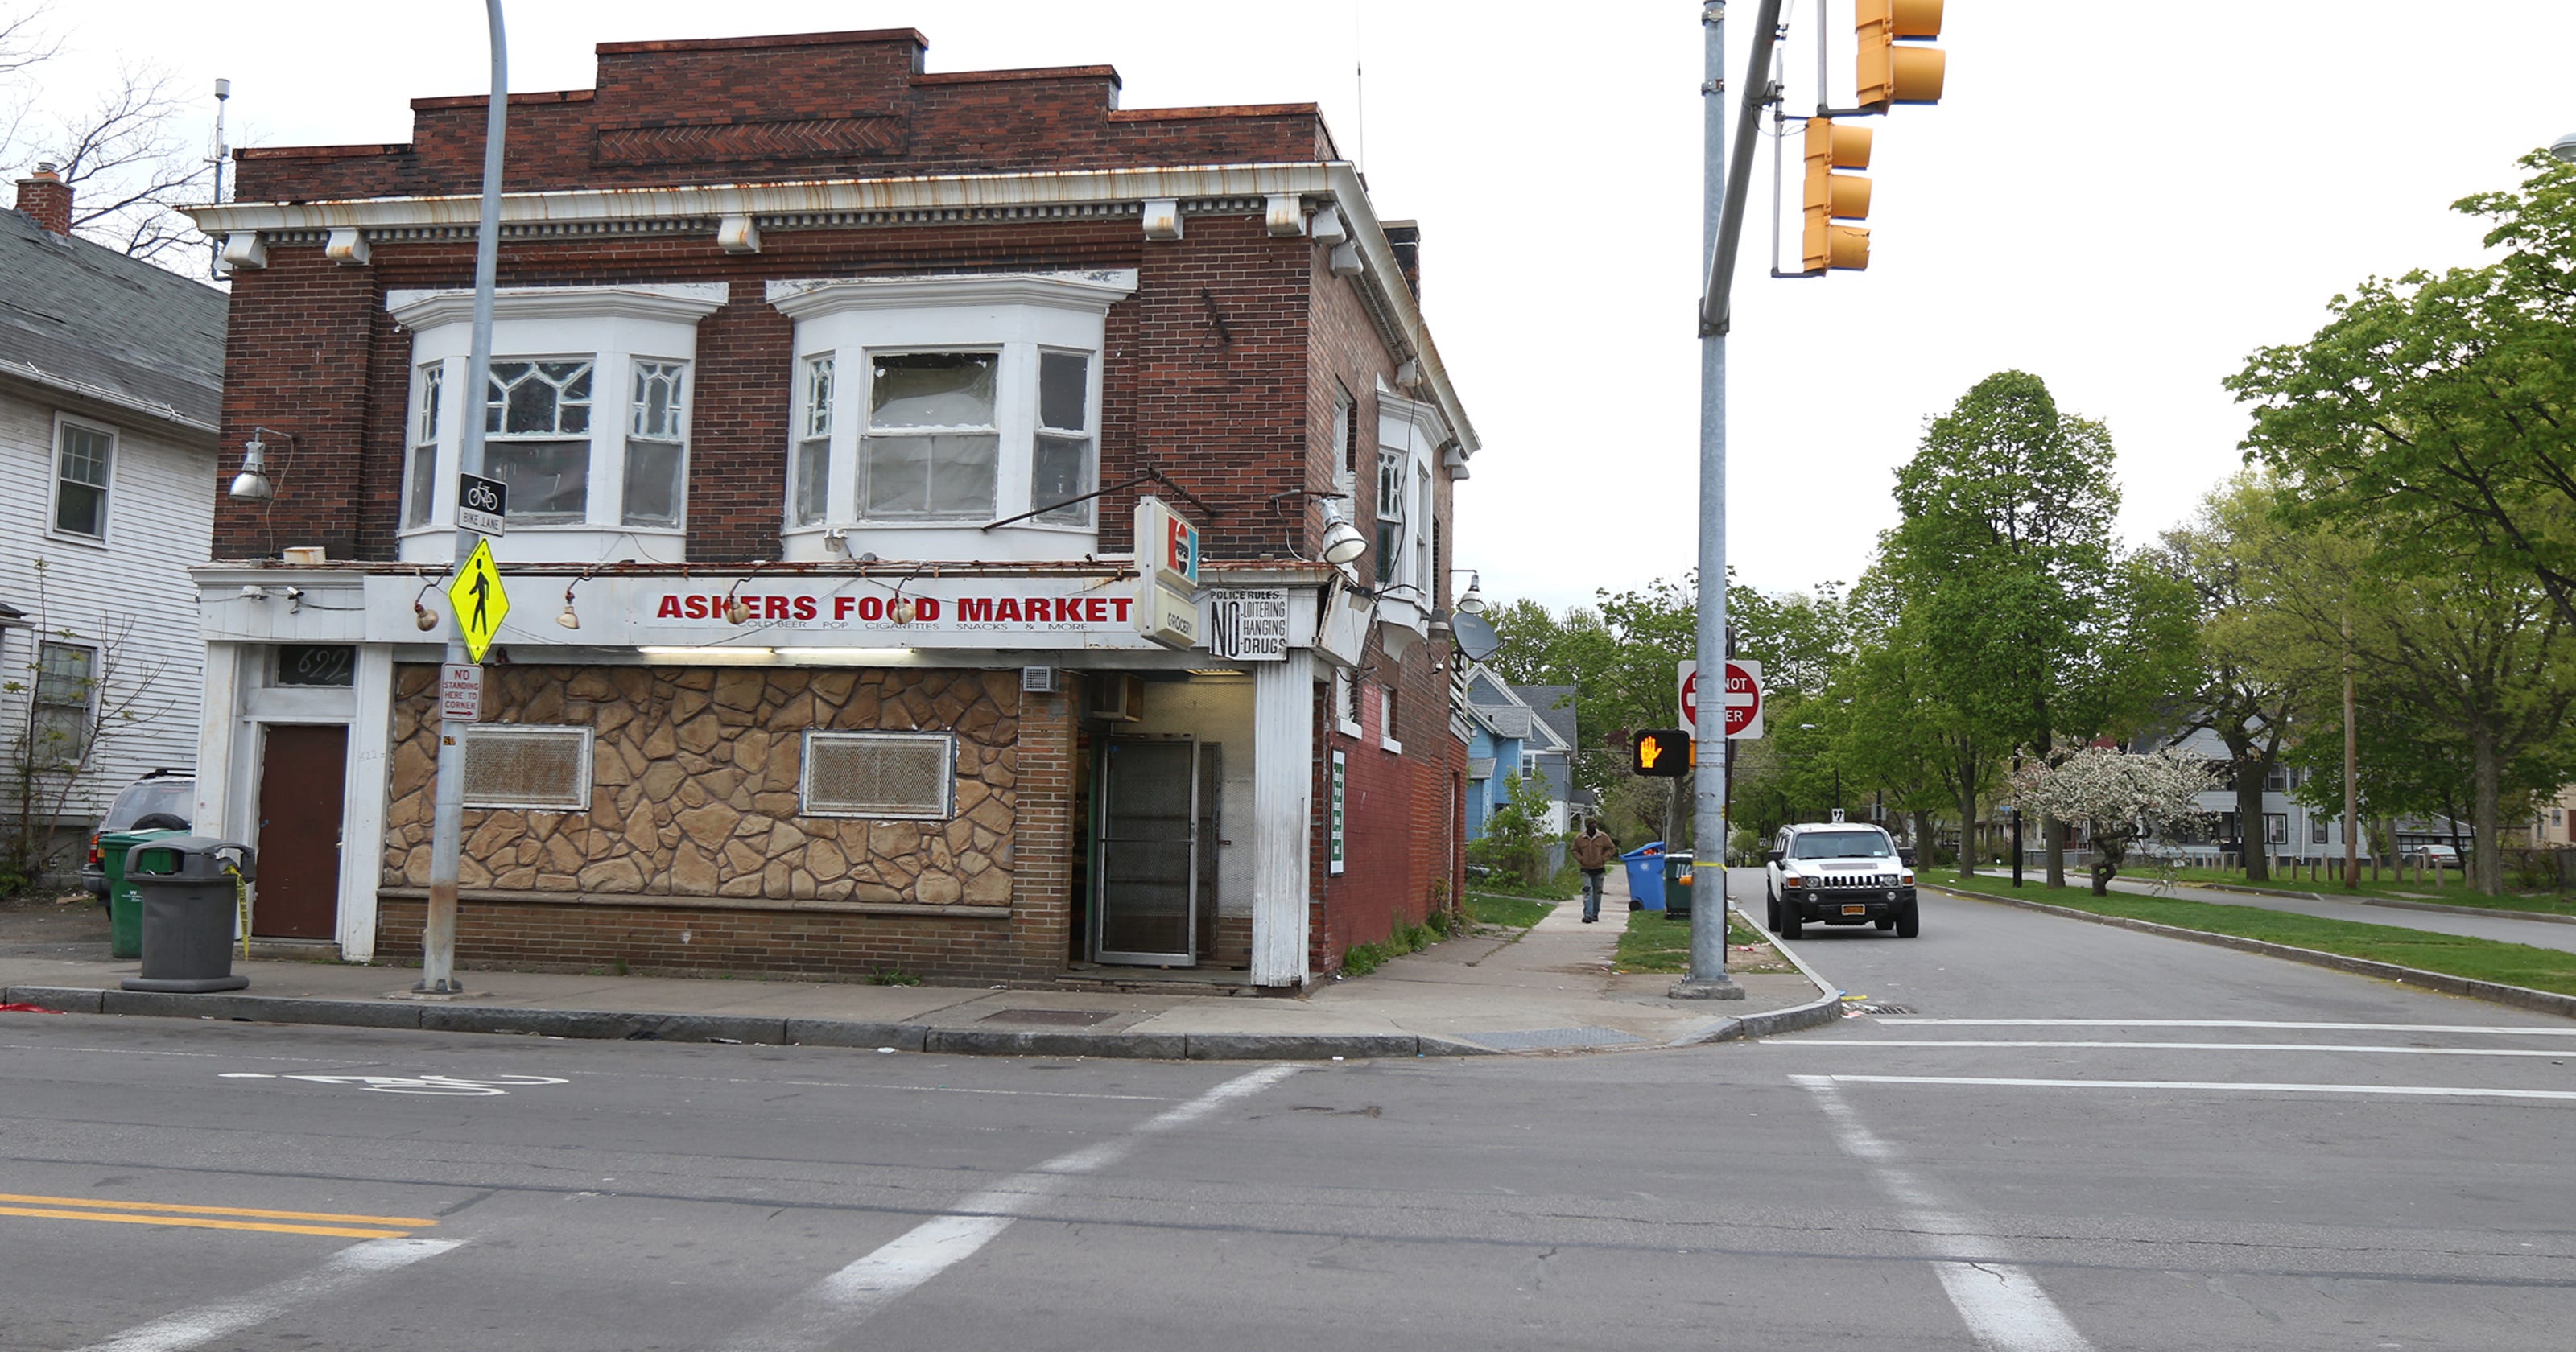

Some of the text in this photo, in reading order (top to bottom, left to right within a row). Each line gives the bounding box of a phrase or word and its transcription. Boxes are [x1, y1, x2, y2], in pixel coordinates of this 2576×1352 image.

[464, 512, 499, 530] BIKE LANE
[1210, 591, 1245, 599] POLICE
[958, 598, 1133, 622] MARKET
[1243, 601, 1286, 618] LOITERING
[823, 621, 849, 629] POP
[1167, 612, 1191, 634] GROCERY
[1211, 601, 1240, 657] NO
[1243, 620, 1286, 636] HANGING
[1243, 638, 1287, 654] DRUGS
[454, 670, 469, 680] NO
[444, 682, 479, 690] STANDING
[444, 691, 464, 699] HERE
[445, 701, 476, 709] CORNER
